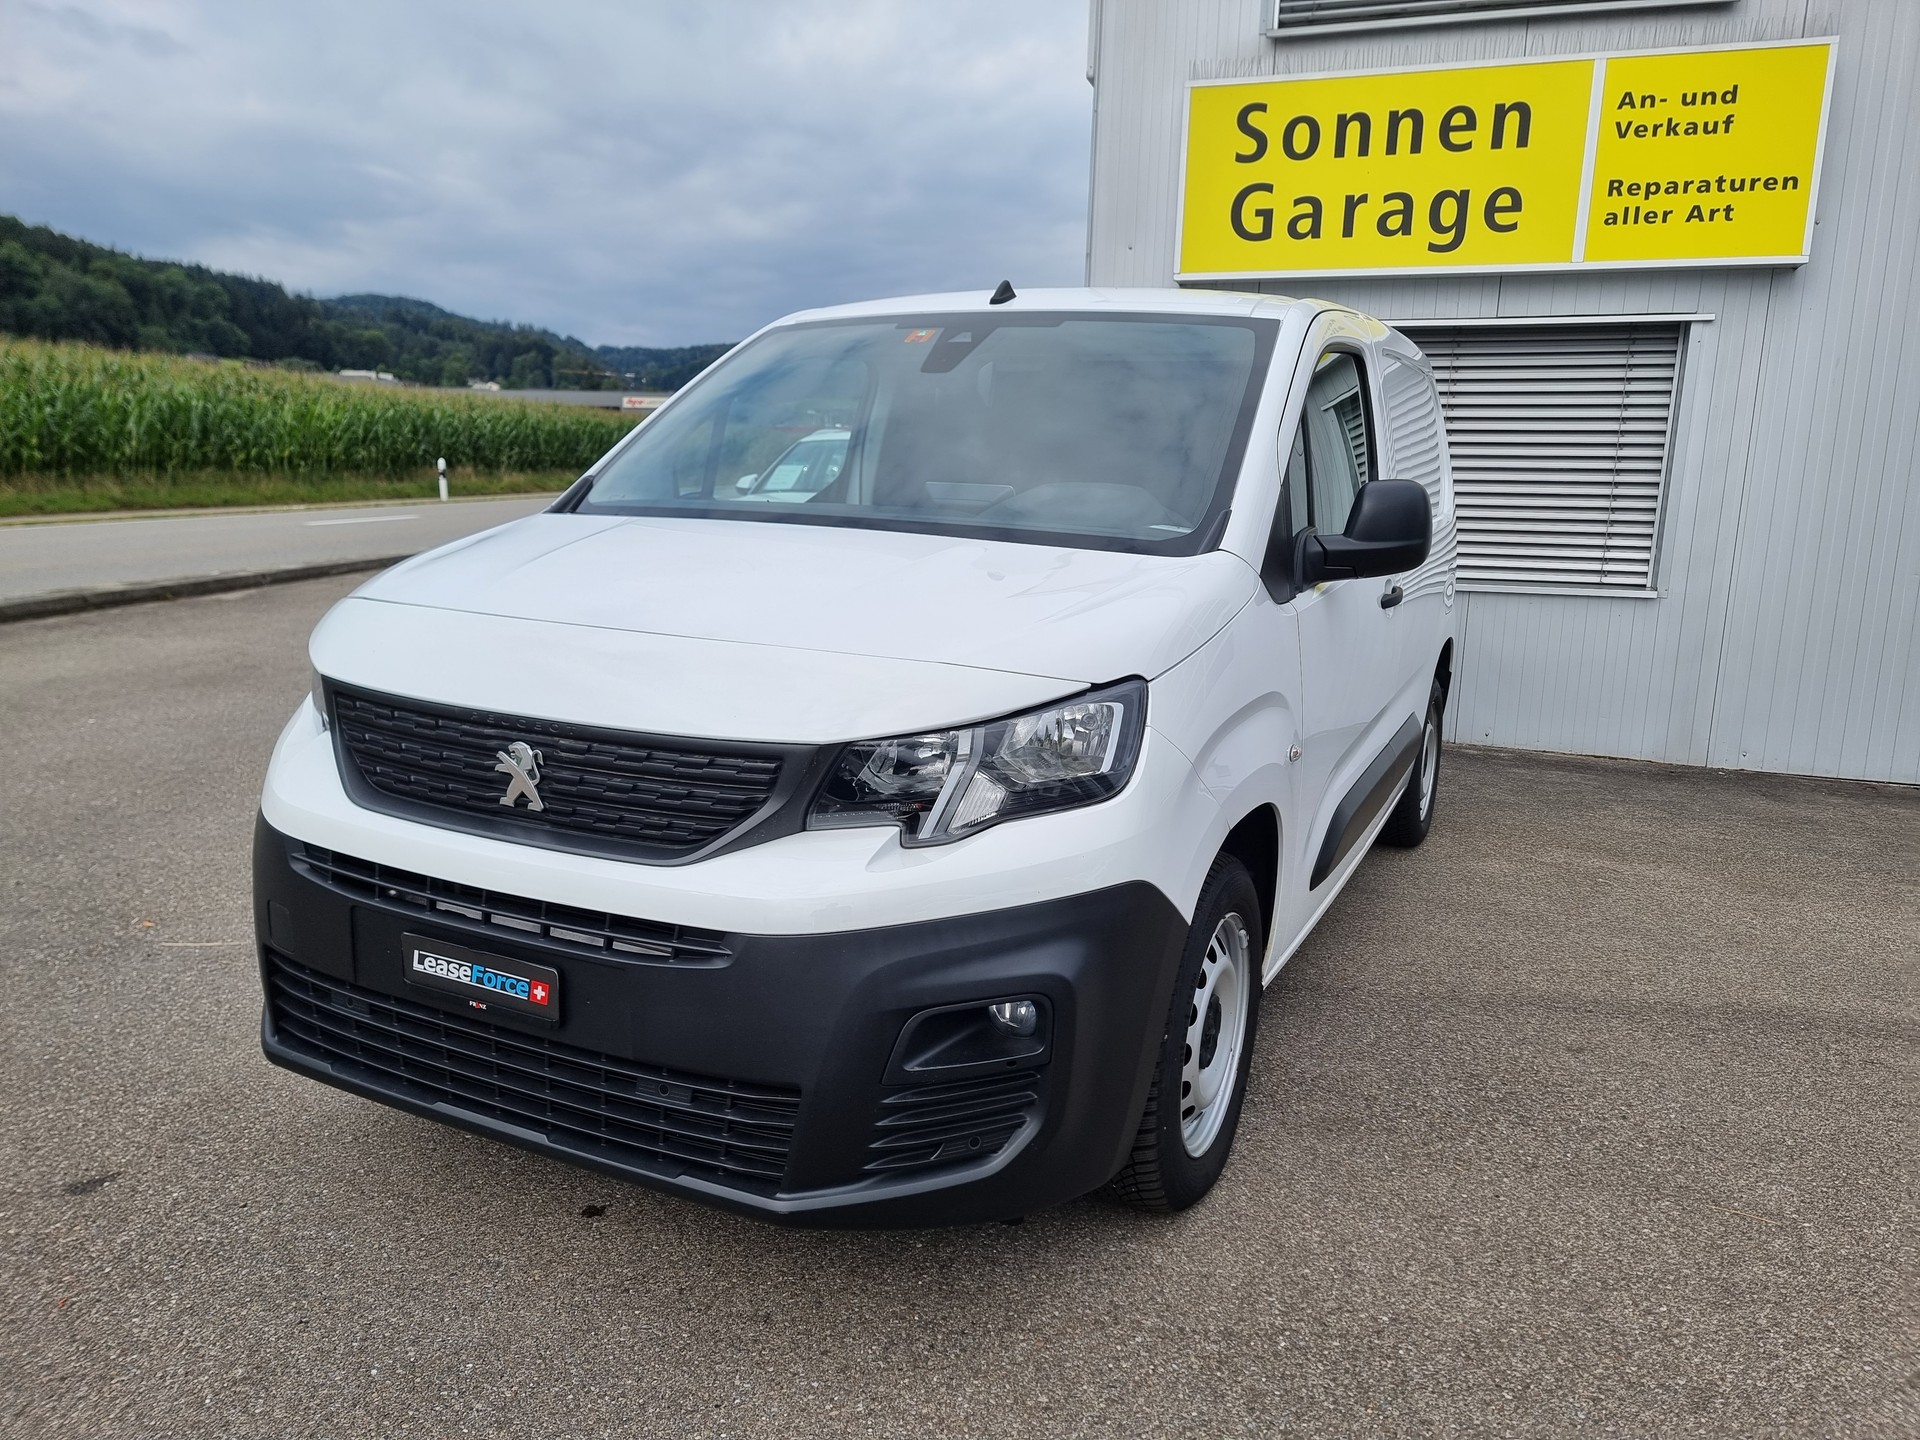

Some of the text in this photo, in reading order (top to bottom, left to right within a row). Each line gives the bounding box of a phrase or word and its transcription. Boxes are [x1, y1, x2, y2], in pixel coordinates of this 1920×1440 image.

[1616, 84, 1739, 109] An- und
[1234, 101, 1532, 164] Sonnen
[1615, 114, 1736, 139] Verkauf
[1607, 175, 1799, 201] Reparaturen
[1229, 182, 1523, 253] Garage
[1603, 203, 1735, 226] aller Art
[470, 710, 577, 736] PEUGEOT
[412, 949, 530, 998] LeaseForce
